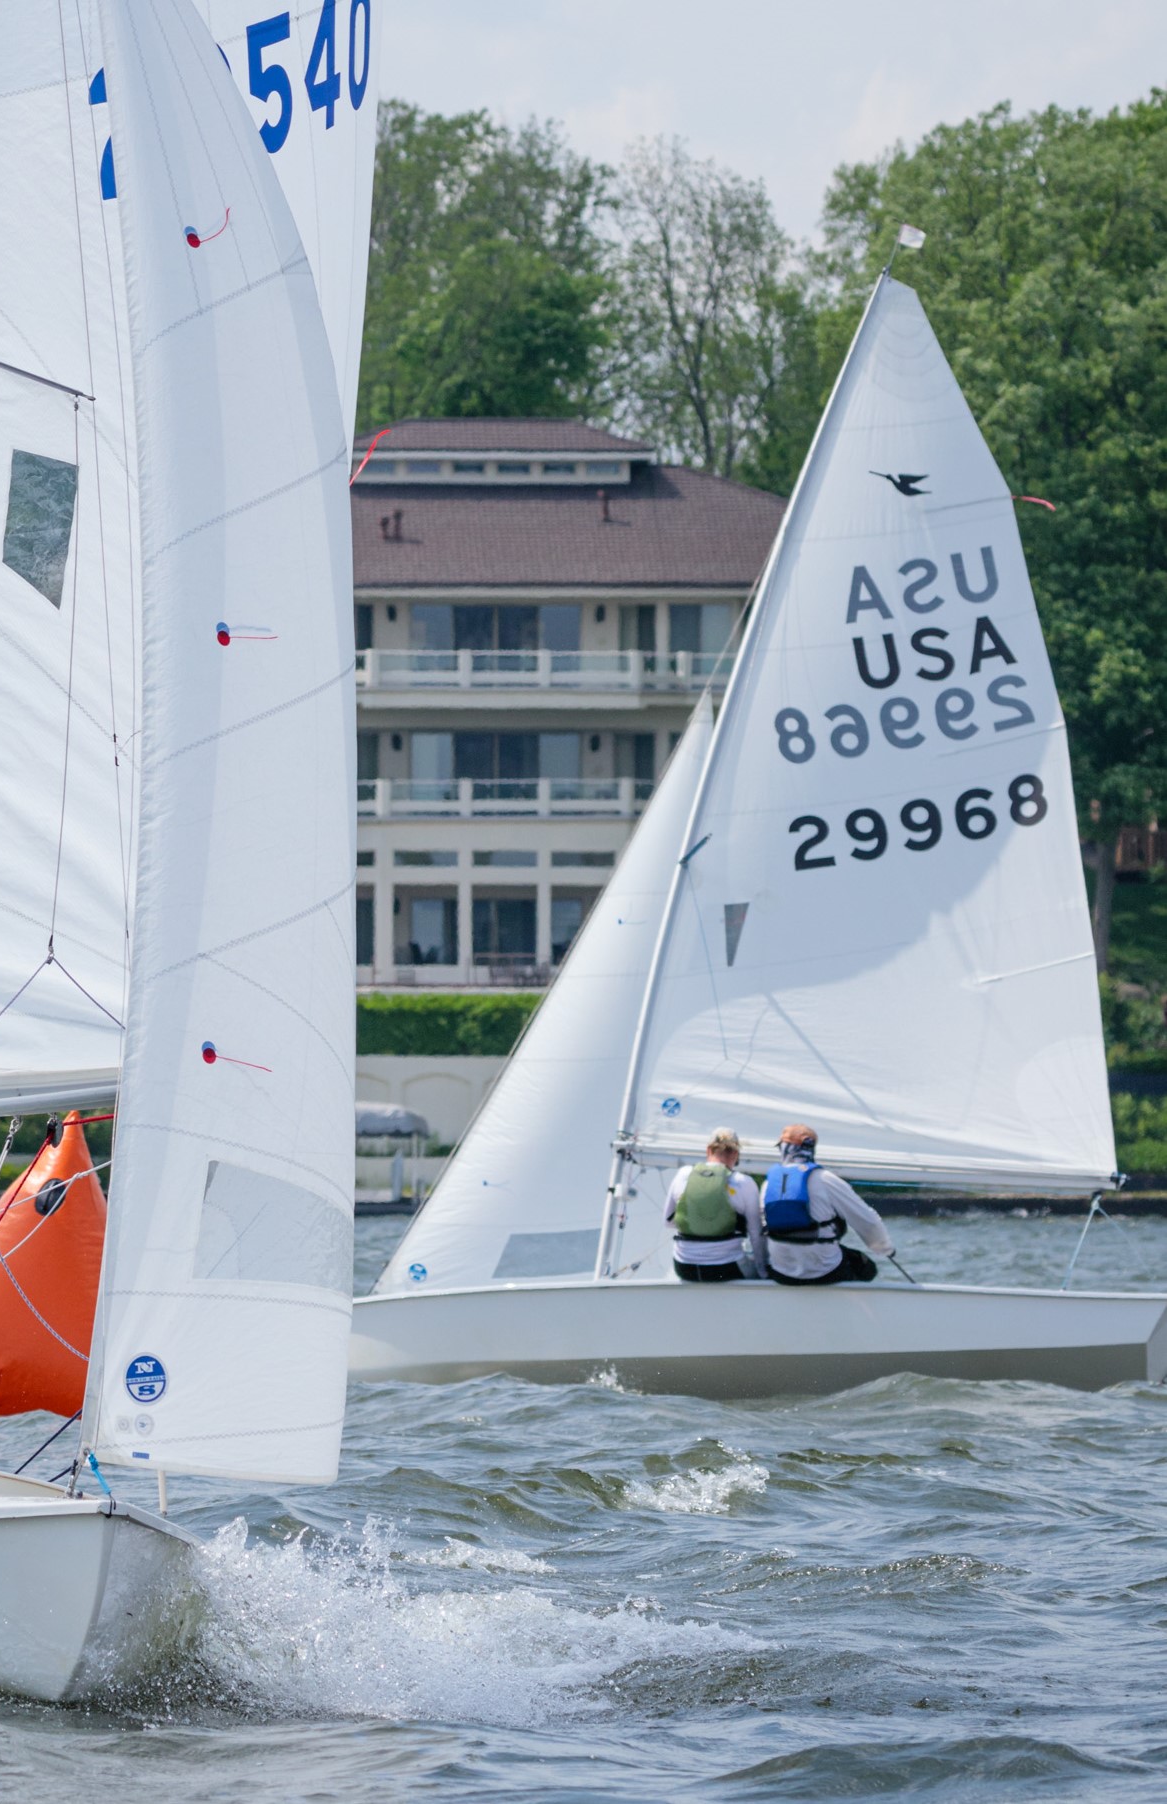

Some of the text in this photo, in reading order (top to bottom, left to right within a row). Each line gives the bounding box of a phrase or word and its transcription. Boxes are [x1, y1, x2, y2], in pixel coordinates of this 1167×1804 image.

[852, 616, 1018, 690] USA
[789, 774, 1048, 871] 29968
[134, 1361, 156, 1374] N
[138, 1384, 156, 1396] S
